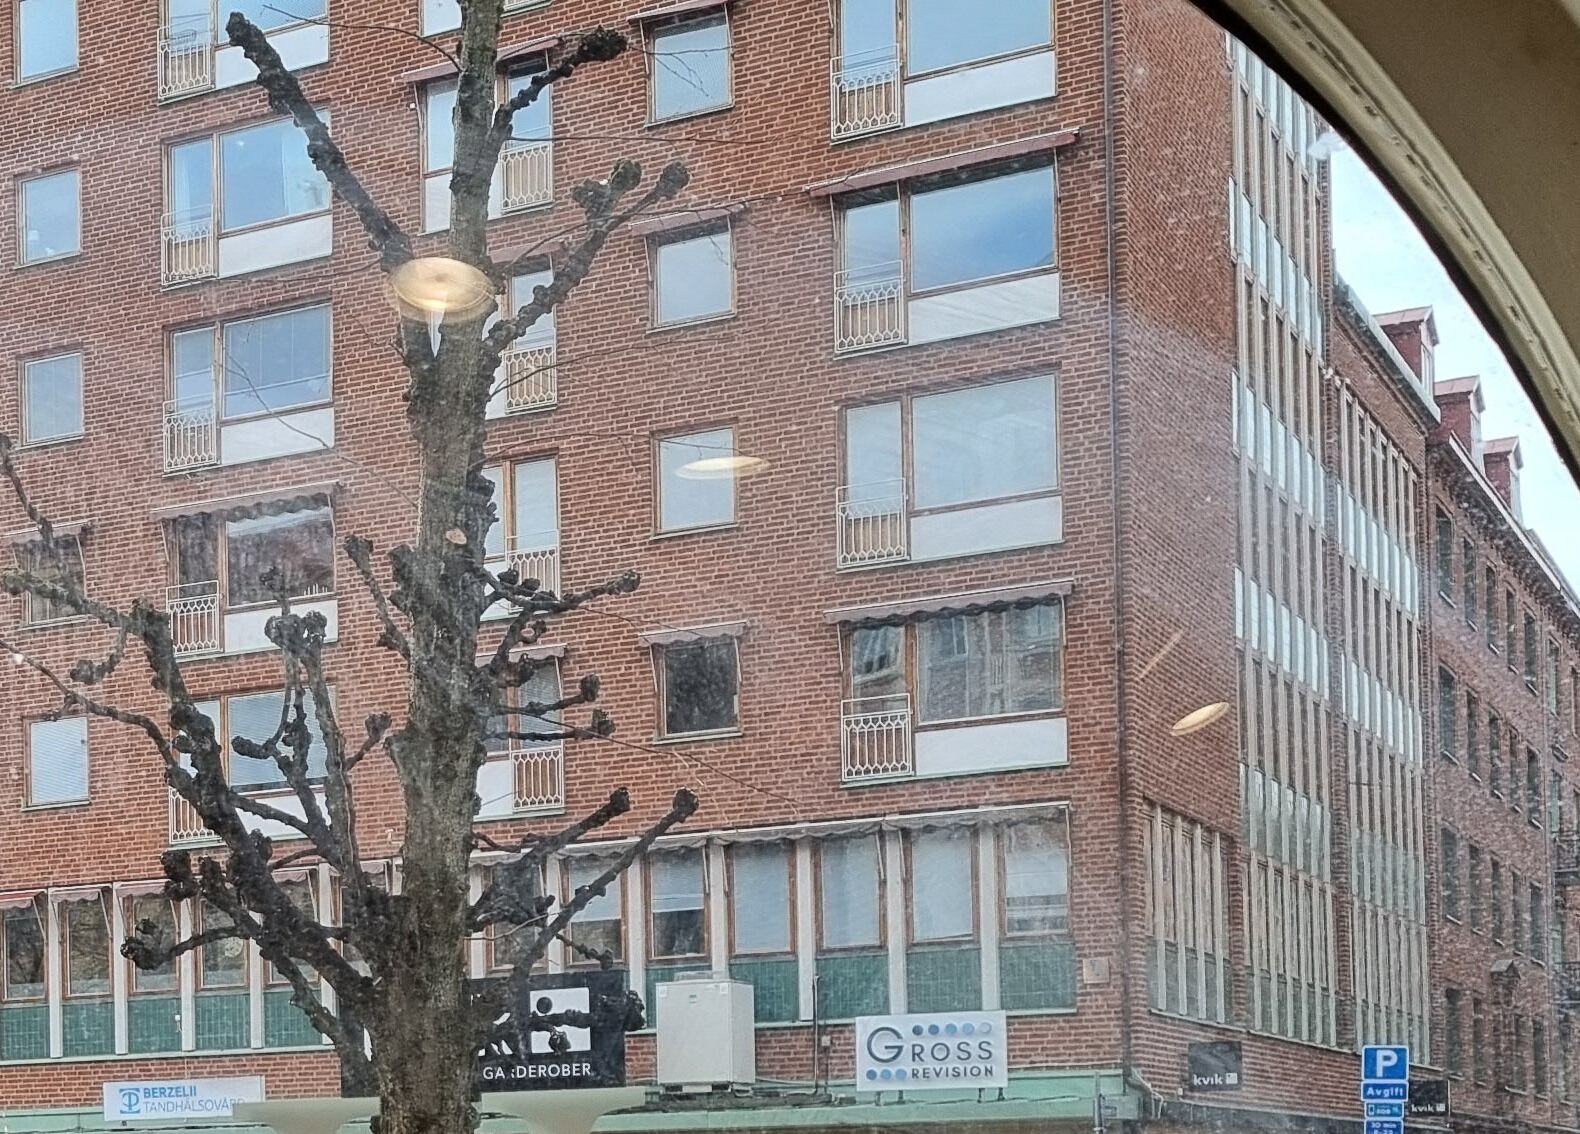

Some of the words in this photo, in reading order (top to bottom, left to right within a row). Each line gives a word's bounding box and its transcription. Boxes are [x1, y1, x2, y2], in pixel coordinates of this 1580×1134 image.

[867, 1026, 993, 1063] GROSS
[1376, 1049, 1398, 1077] P
[911, 1065, 994, 1079] REVISION
[1193, 1073, 1223, 1086] kvik
[143, 1086, 197, 1099] BERZELII
[1366, 1087, 1403, 1097] Avgift
[1411, 1103, 1434, 1113] kvik
